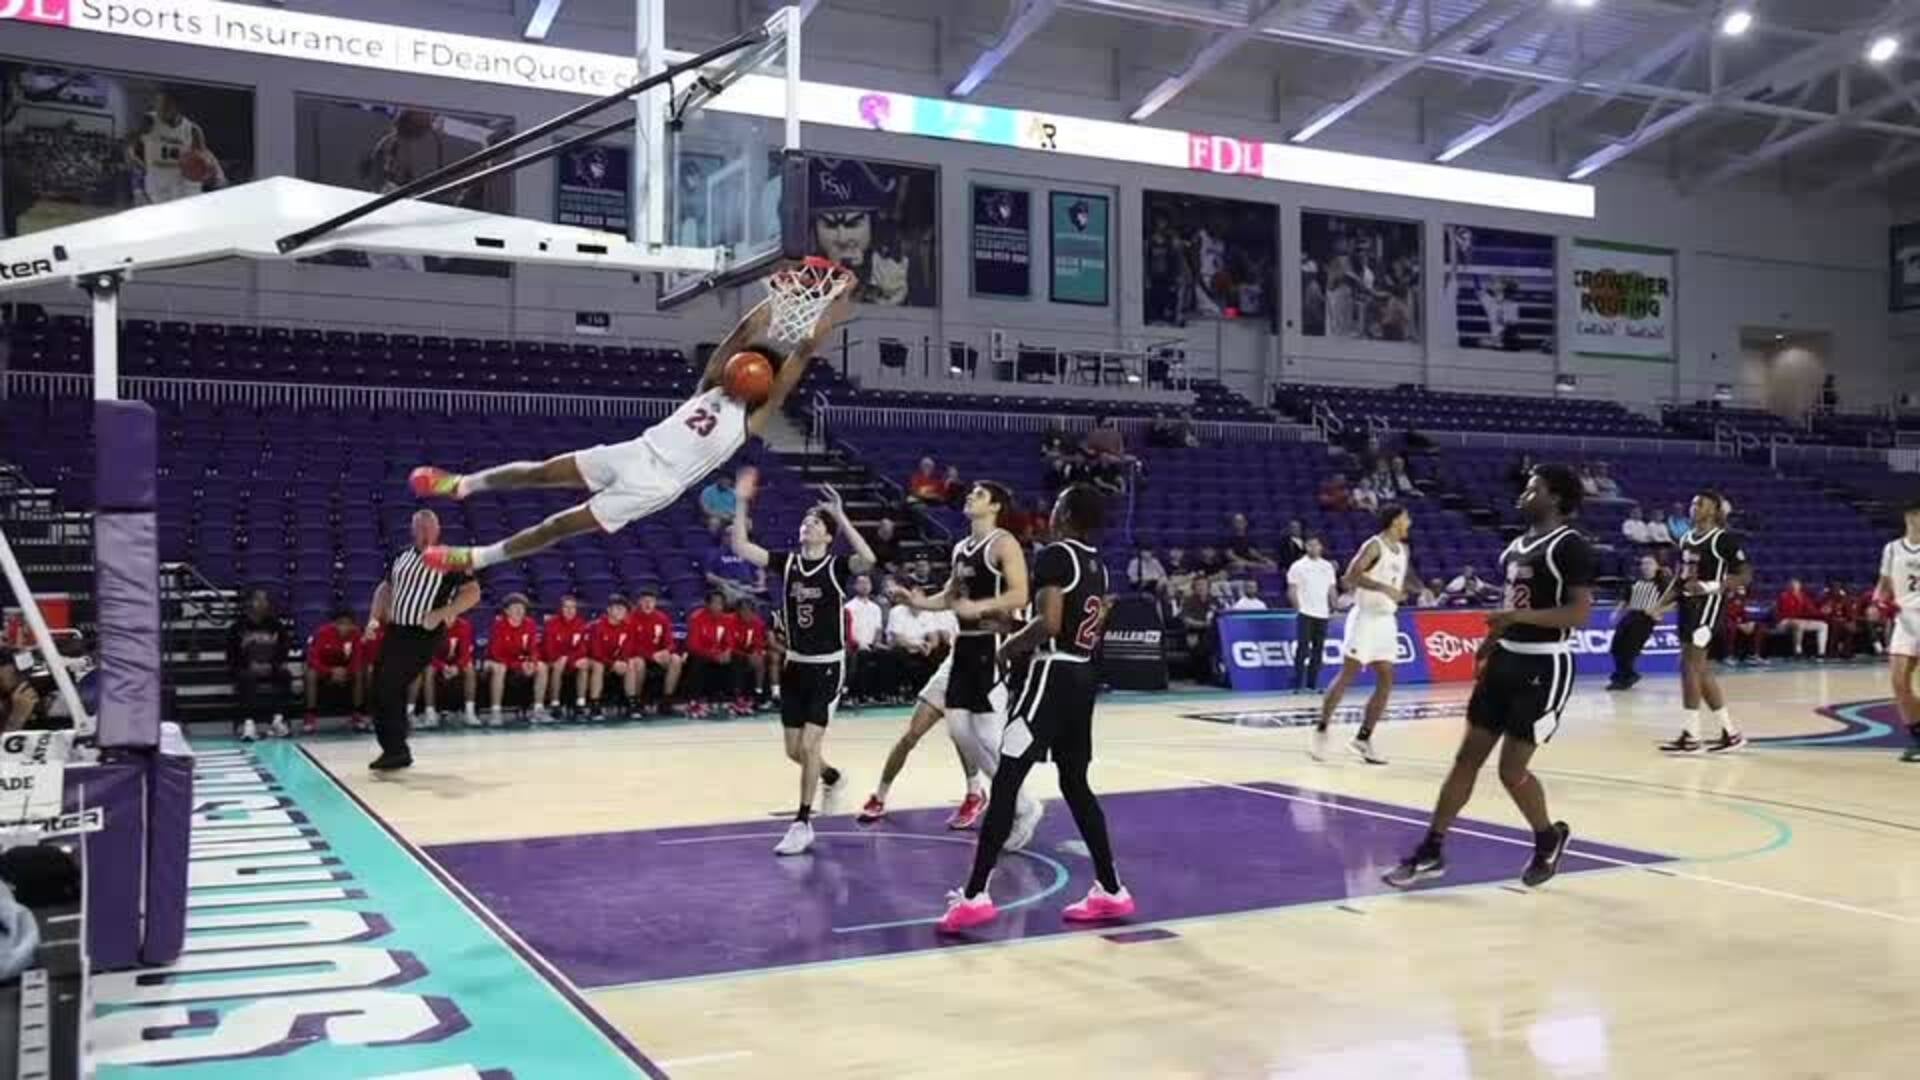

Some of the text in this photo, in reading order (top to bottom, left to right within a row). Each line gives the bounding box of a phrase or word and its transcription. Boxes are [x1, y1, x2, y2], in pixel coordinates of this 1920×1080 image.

[82, 0, 203, 35] Sports
[214, 14, 384, 58] Insurance
[1192, 133, 1263, 176] FDL
[819, 168, 850, 199] FSW
[684, 407, 717, 437] 23
[797, 604, 814, 628] 5
[1231, 638, 1345, 668] GEIO
